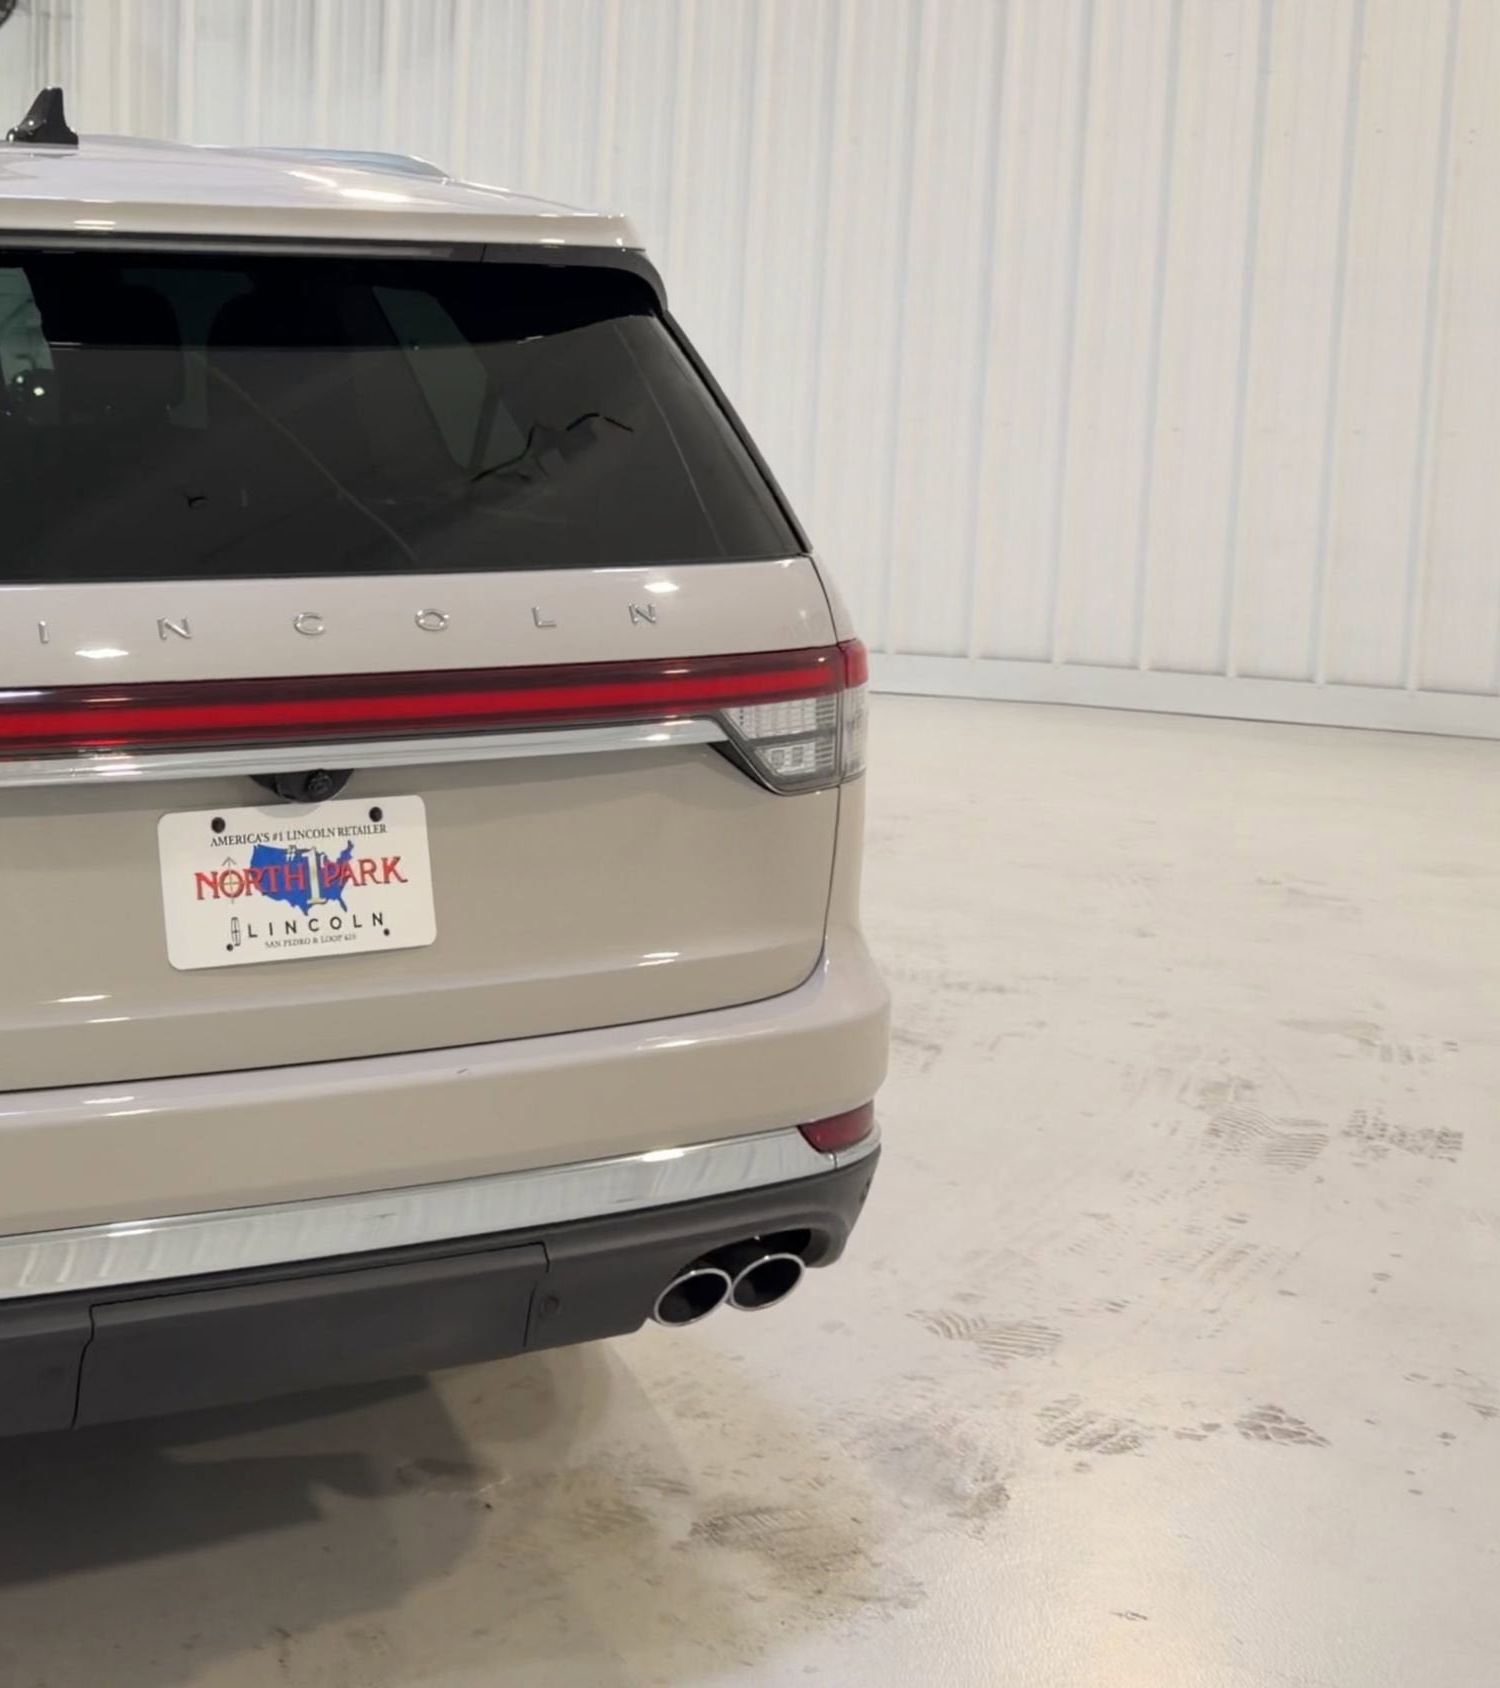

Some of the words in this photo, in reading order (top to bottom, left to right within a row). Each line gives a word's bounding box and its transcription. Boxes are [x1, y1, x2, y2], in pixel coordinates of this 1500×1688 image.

[210, 833, 270, 847] AMERICA'S
[272, 832, 284, 842] #1
[286, 827, 335, 841] LINCOLN
[337, 824, 387, 837] RETAILER
[194, 864, 307, 901] NORTH
[323, 856, 409, 888] PARK
[247, 912, 384, 938] LINCOLN
